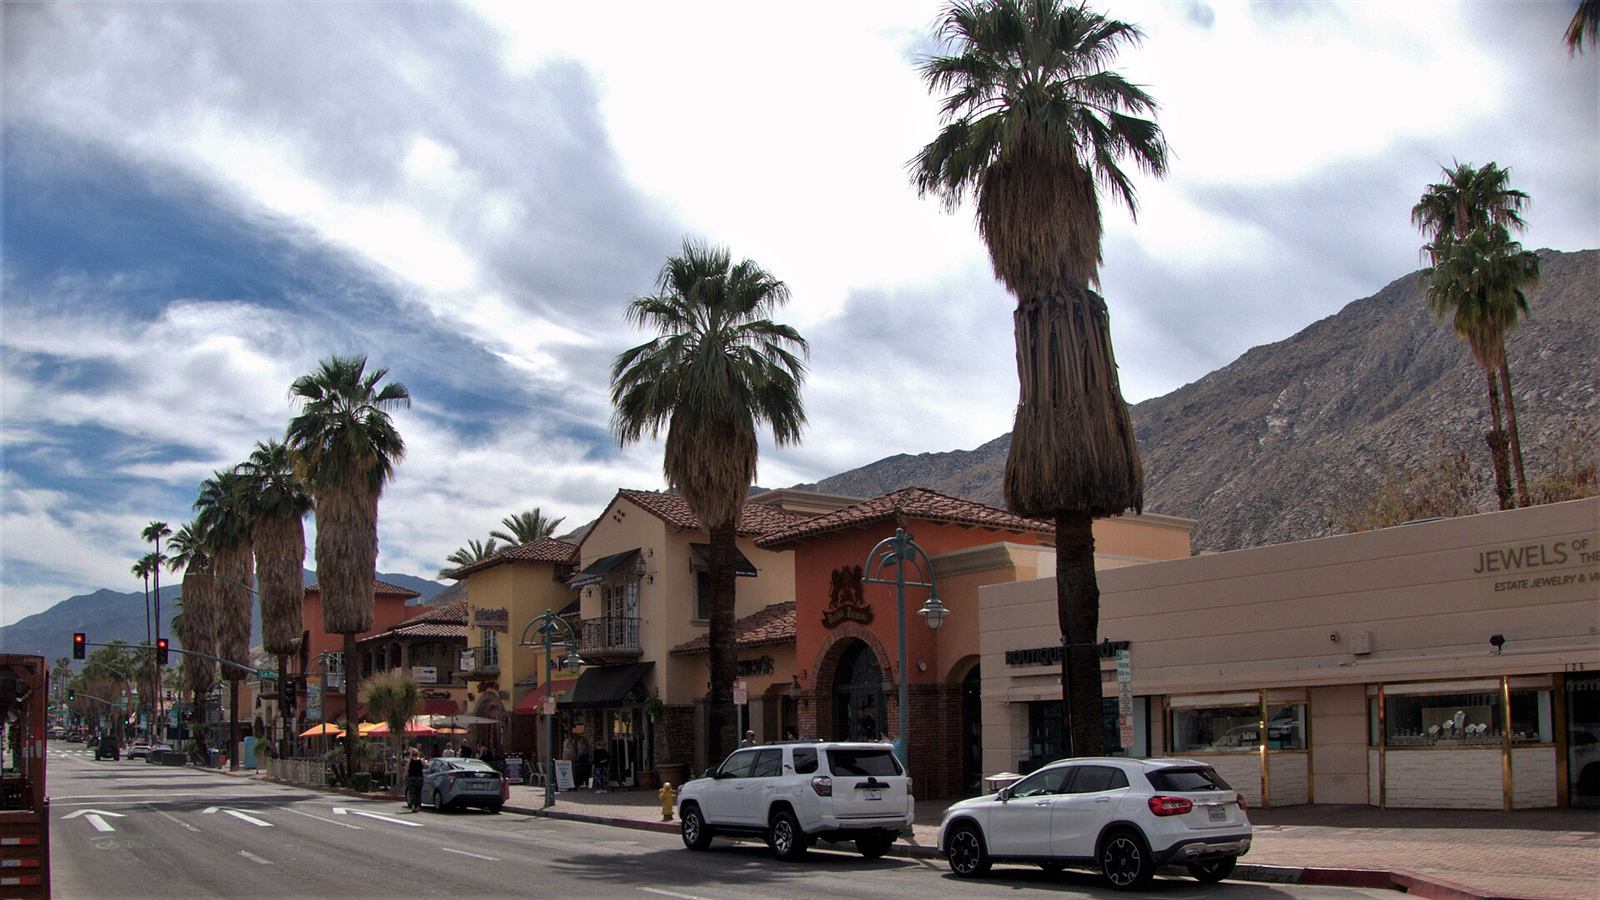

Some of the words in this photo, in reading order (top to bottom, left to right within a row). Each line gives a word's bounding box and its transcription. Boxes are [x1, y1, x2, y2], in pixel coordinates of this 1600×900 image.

[1473, 541, 1568, 574] JEWELS
[1571, 539, 1589, 551] OF
[1579, 551, 1600, 563] THE
[1494, 579, 1529, 592] ESTATE
[1530, 574, 1577, 588] JEWELRY
[1578, 573, 1586, 583] &
